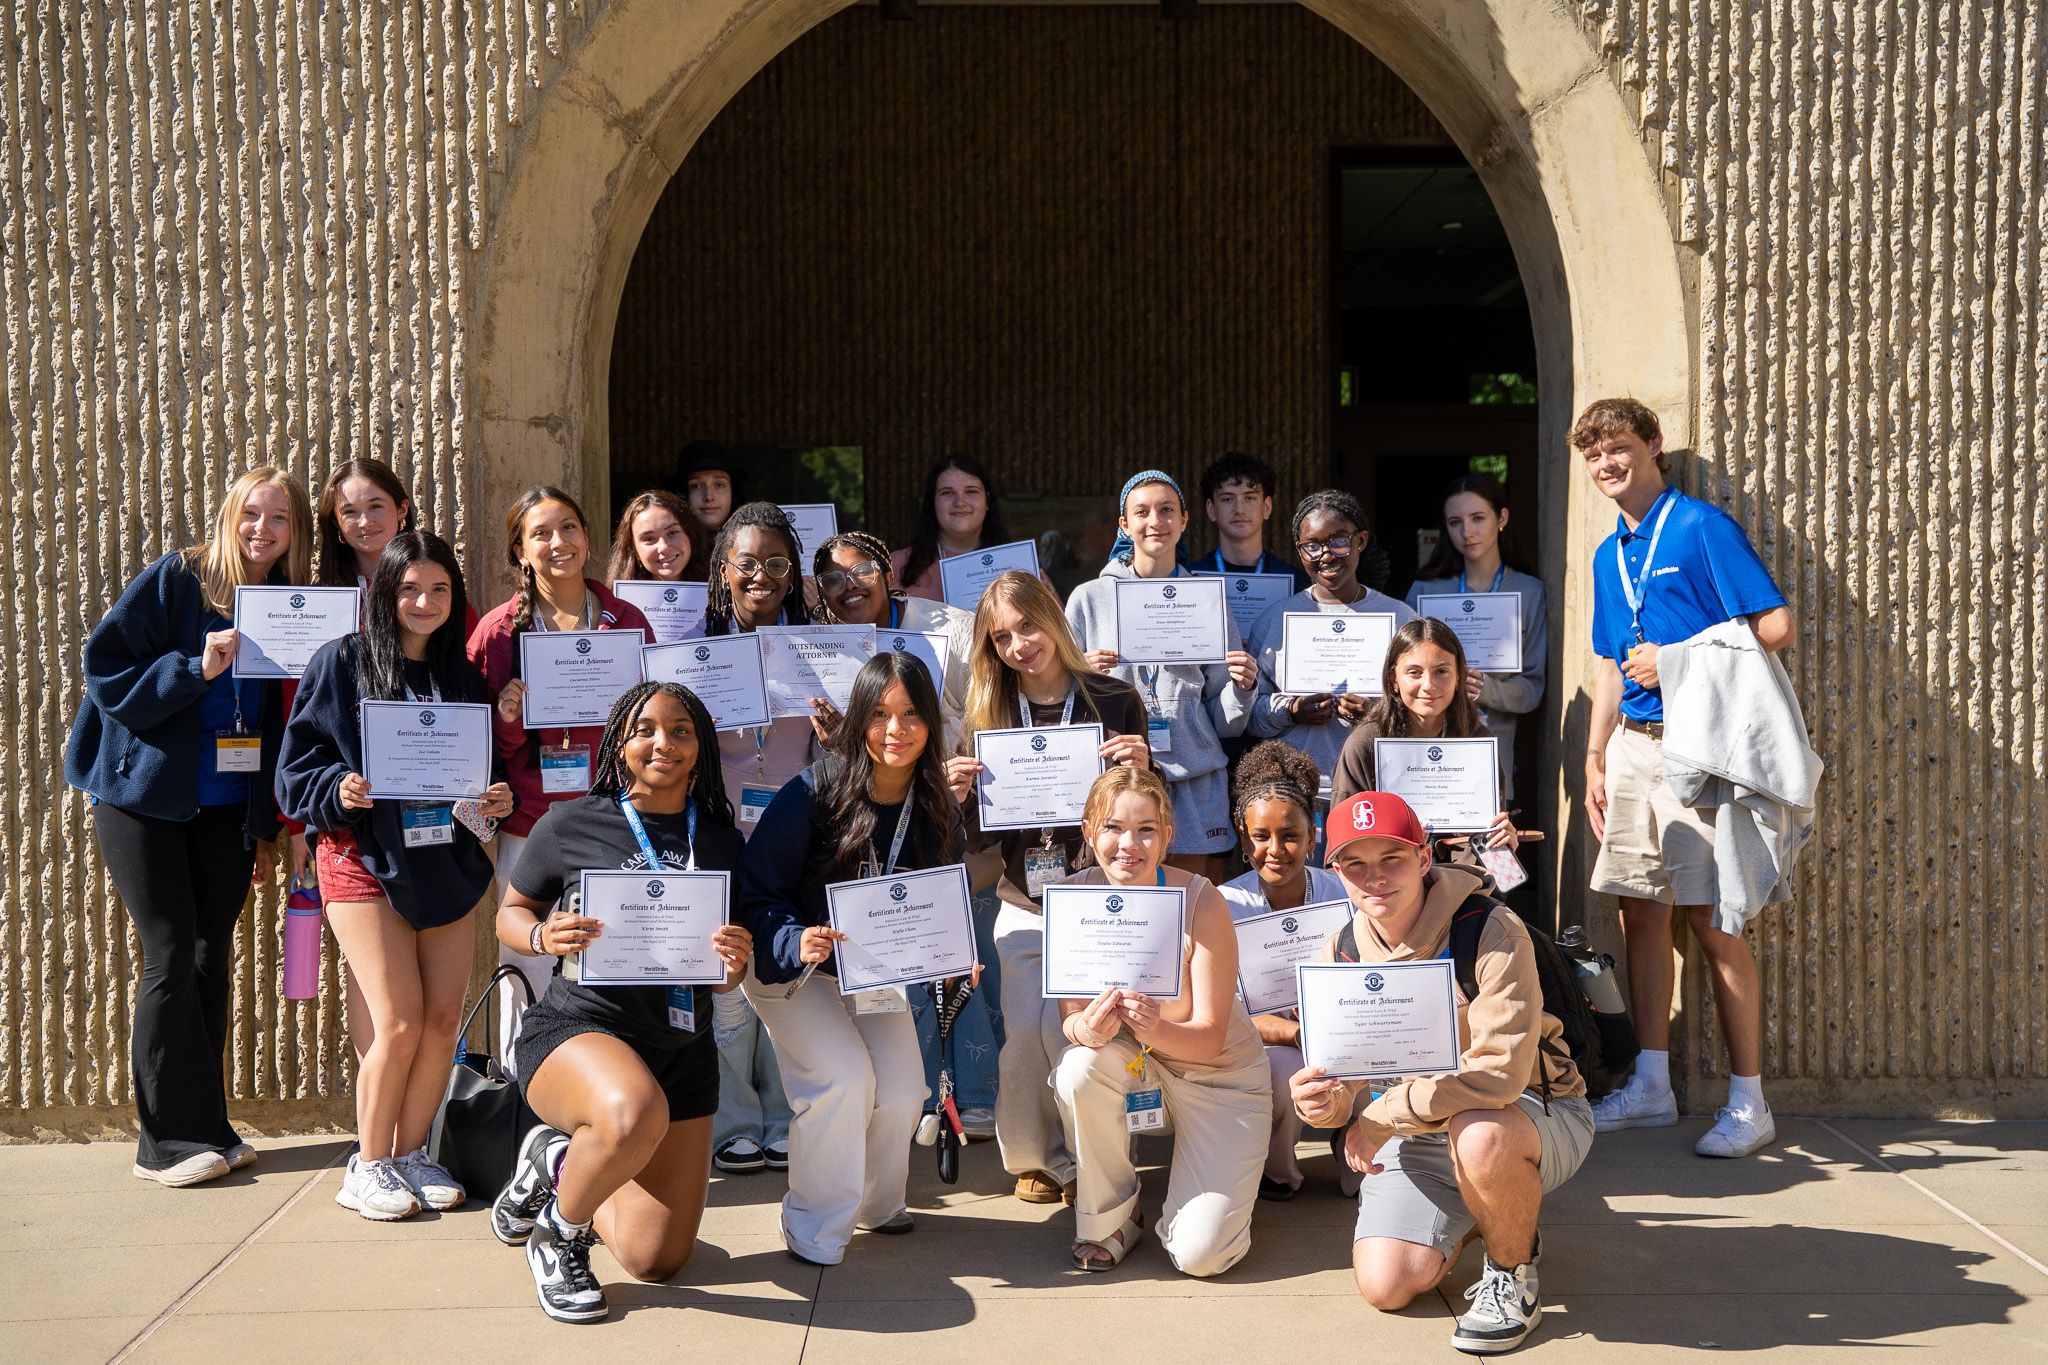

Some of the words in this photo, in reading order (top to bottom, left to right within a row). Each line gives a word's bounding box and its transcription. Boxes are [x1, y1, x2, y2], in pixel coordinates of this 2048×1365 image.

[658, 904, 690, 912] Achievement
[868, 907, 895, 918] Certificate
[904, 902, 934, 913] Achievement
[1109, 918, 1114, 926] of
[1117, 918, 1148, 926] Achievement
[1339, 998, 1368, 1006] Certificate
[1379, 997, 1414, 1006] Achievement
